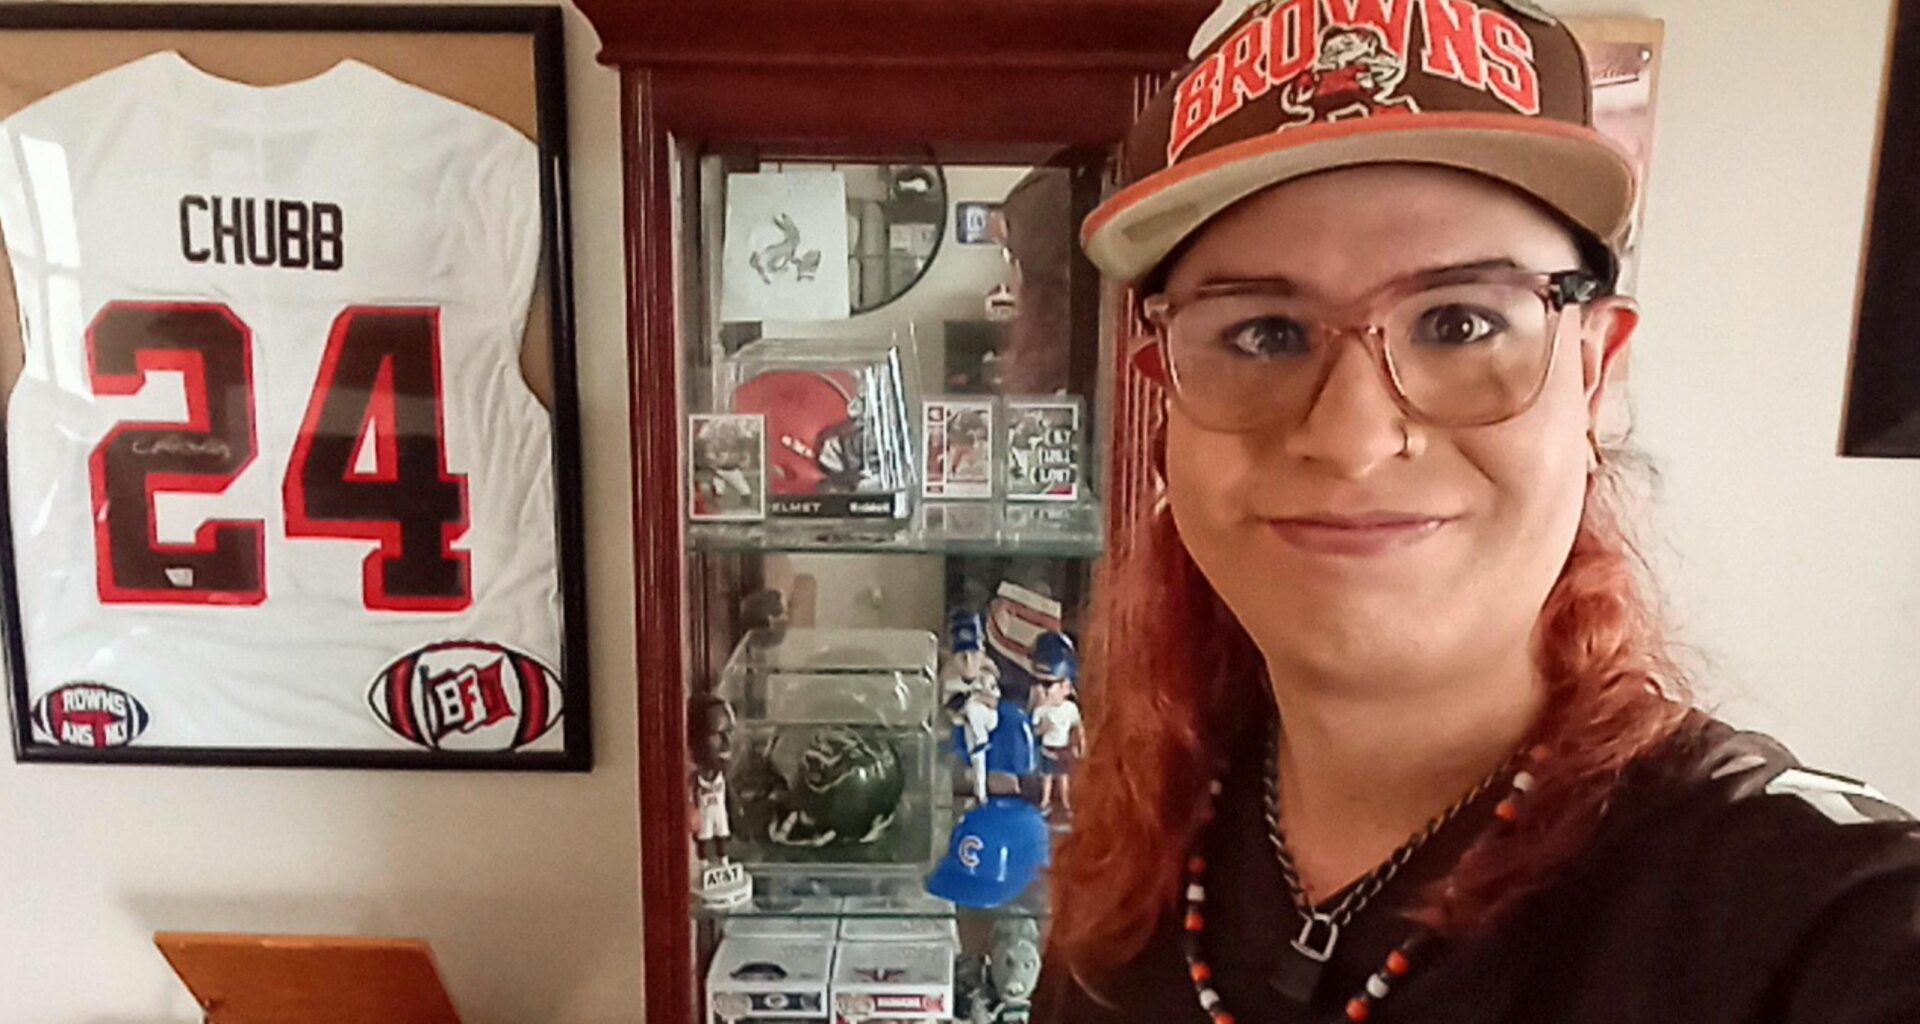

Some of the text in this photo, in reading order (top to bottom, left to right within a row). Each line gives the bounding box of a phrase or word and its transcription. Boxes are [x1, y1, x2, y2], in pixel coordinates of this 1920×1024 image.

[1167, 0, 1540, 168] BROWNS
[179, 194, 345, 271] CHUBB
[84, 299, 472, 612] 24
[767, 501, 822, 513] ELMET
